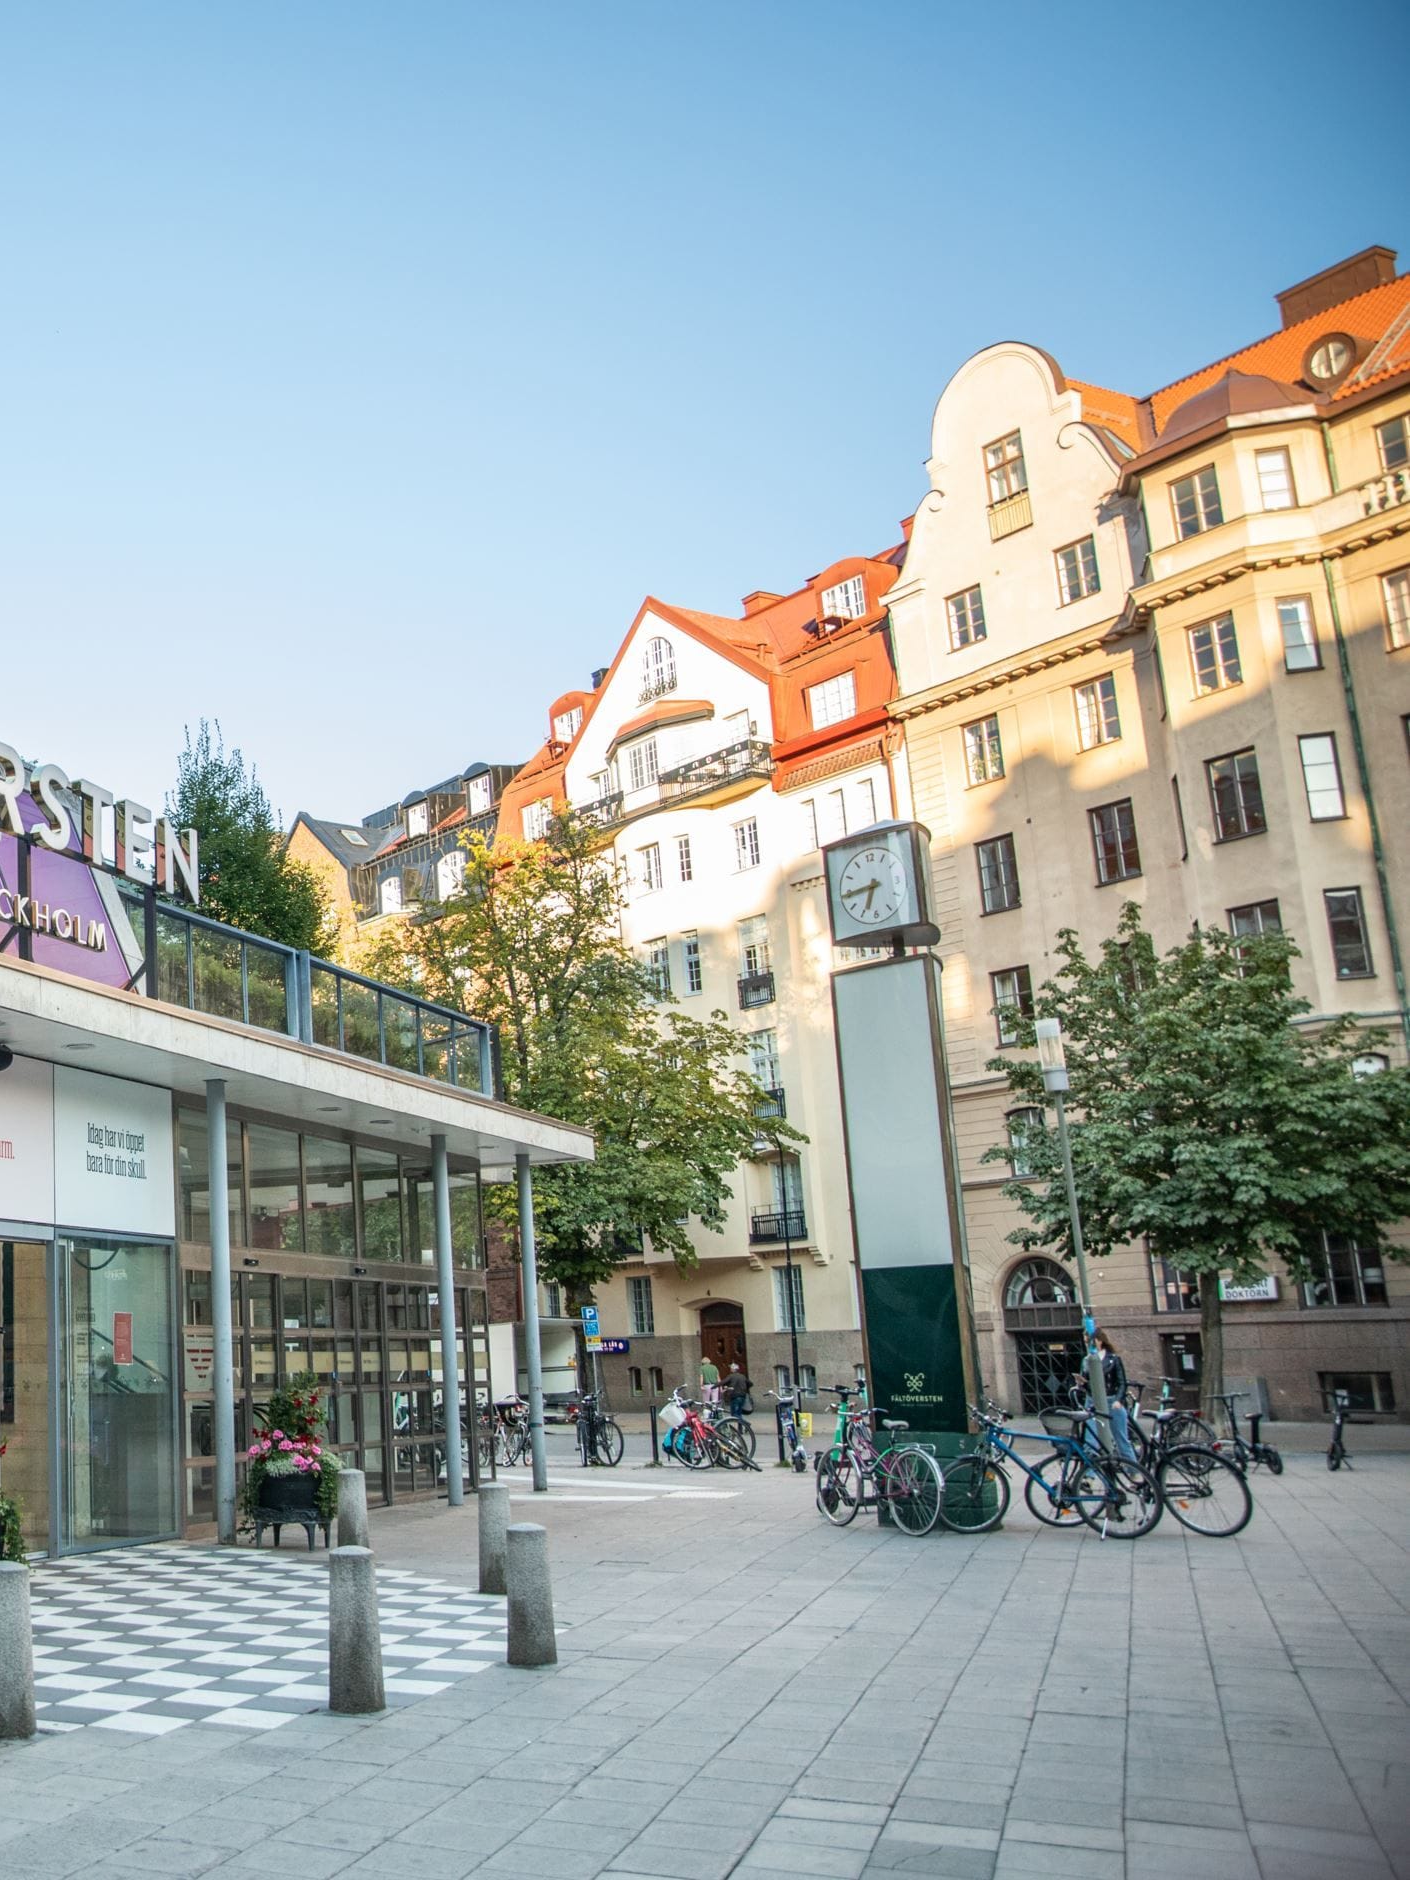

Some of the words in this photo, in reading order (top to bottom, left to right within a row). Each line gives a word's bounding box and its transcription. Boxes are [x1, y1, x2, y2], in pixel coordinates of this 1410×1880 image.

[87, 1122, 104, 1150] Idag
[104, 1125, 117, 1148] har
[117, 1128, 125, 1150] vi
[125, 1130, 145, 1155] öppet
[86, 1150, 103, 1174] bara
[104, 1154, 114, 1176] för
[115, 1154, 127, 1177] din
[127, 1157, 147, 1180] skull.
[1225, 1289, 1270, 1299] DOKTORN
[585, 1308, 595, 1319] P
